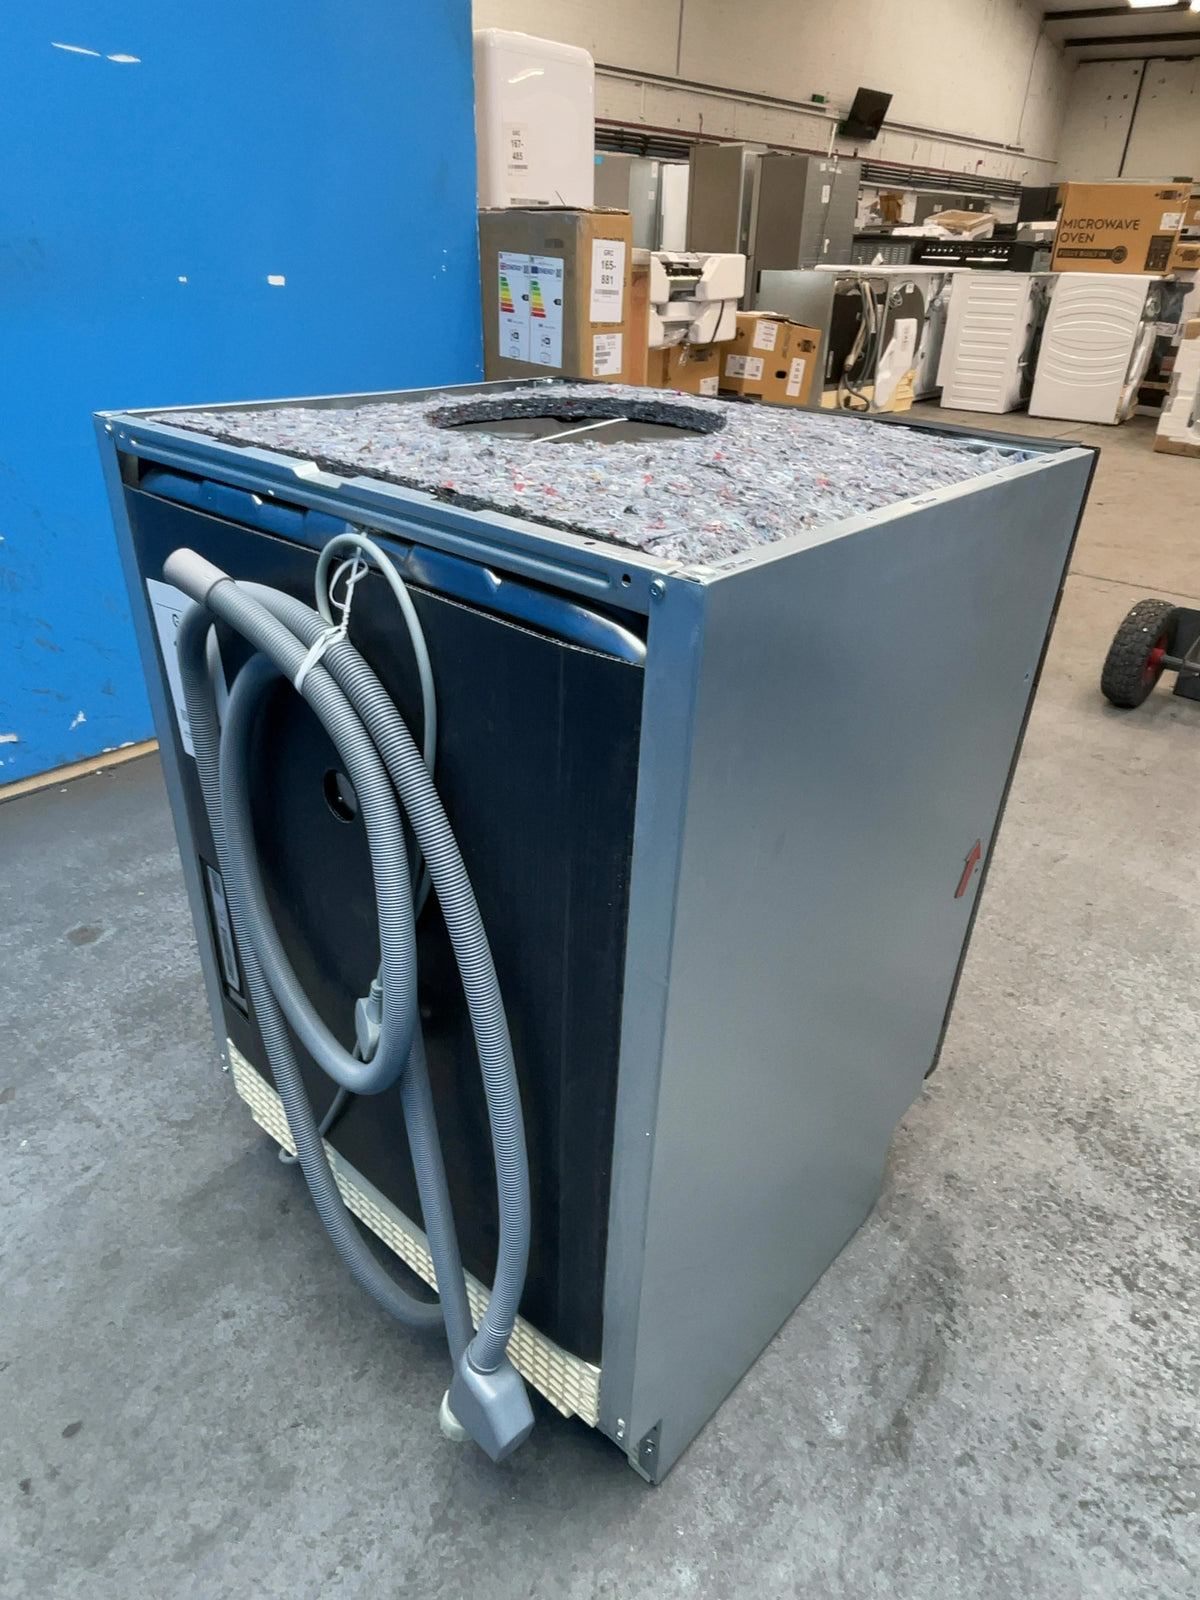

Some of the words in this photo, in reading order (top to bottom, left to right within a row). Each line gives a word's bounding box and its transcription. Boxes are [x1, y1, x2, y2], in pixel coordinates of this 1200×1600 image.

[1062, 218, 1141, 230] MICROWAVE
[1059, 232, 1096, 244] OVEN
[601, 260, 617, 270] 165-
[600, 274, 614, 285] 881
